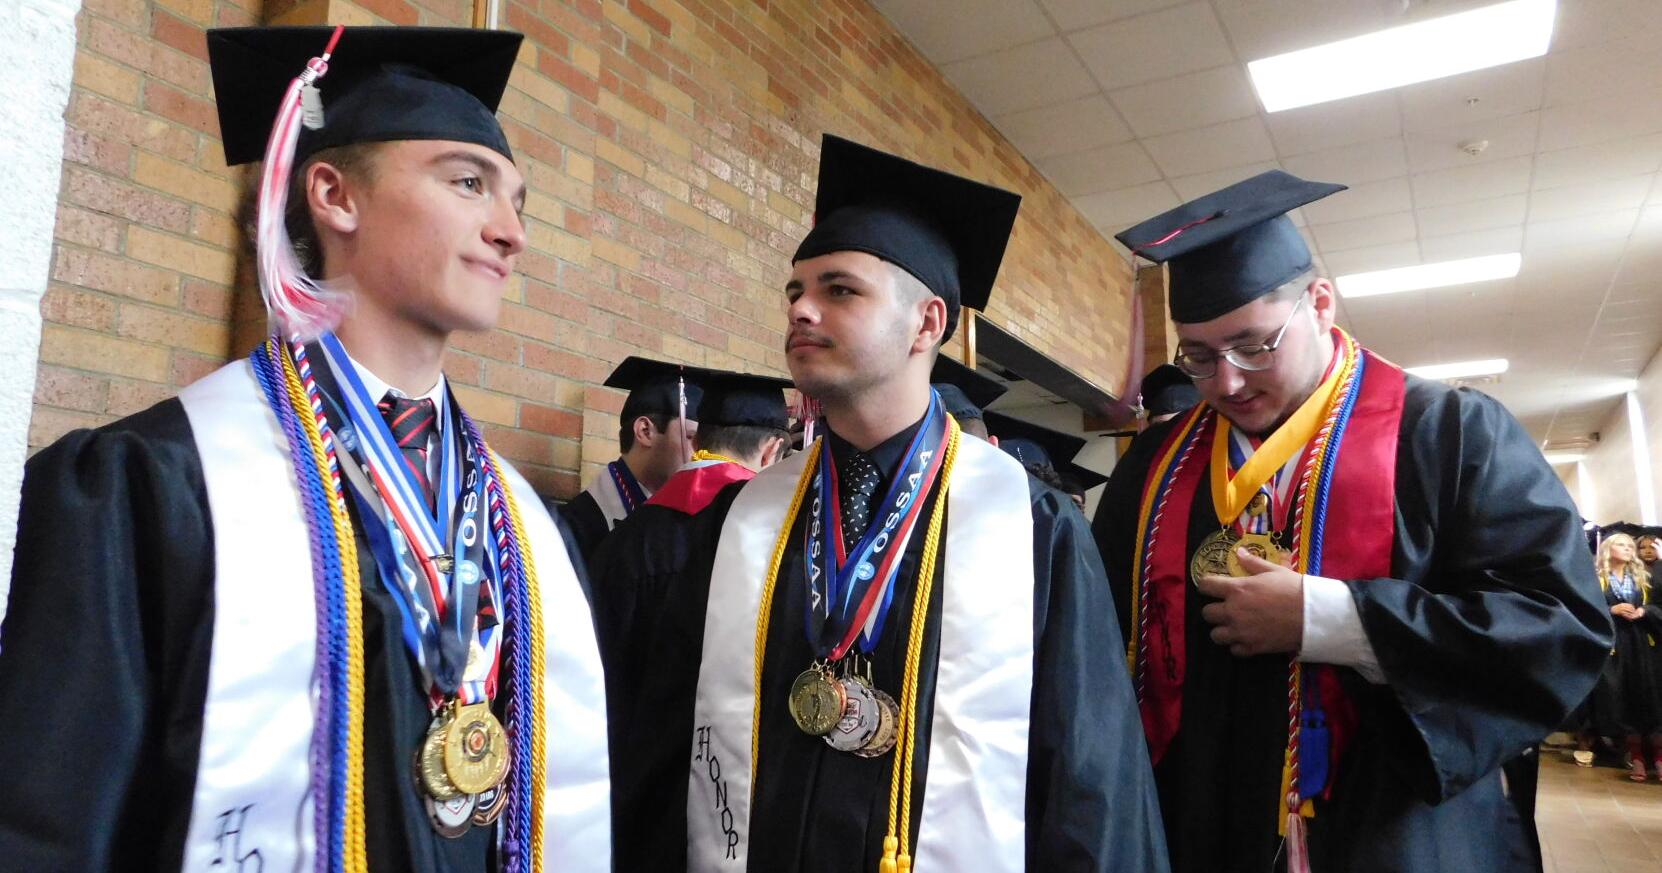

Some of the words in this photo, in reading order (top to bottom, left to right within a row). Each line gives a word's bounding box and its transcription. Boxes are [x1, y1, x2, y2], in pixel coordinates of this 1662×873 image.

[811, 497, 822, 612] OSSAA
[873, 449, 933, 553] OSSAA
[695, 726, 739, 860] HONOR
